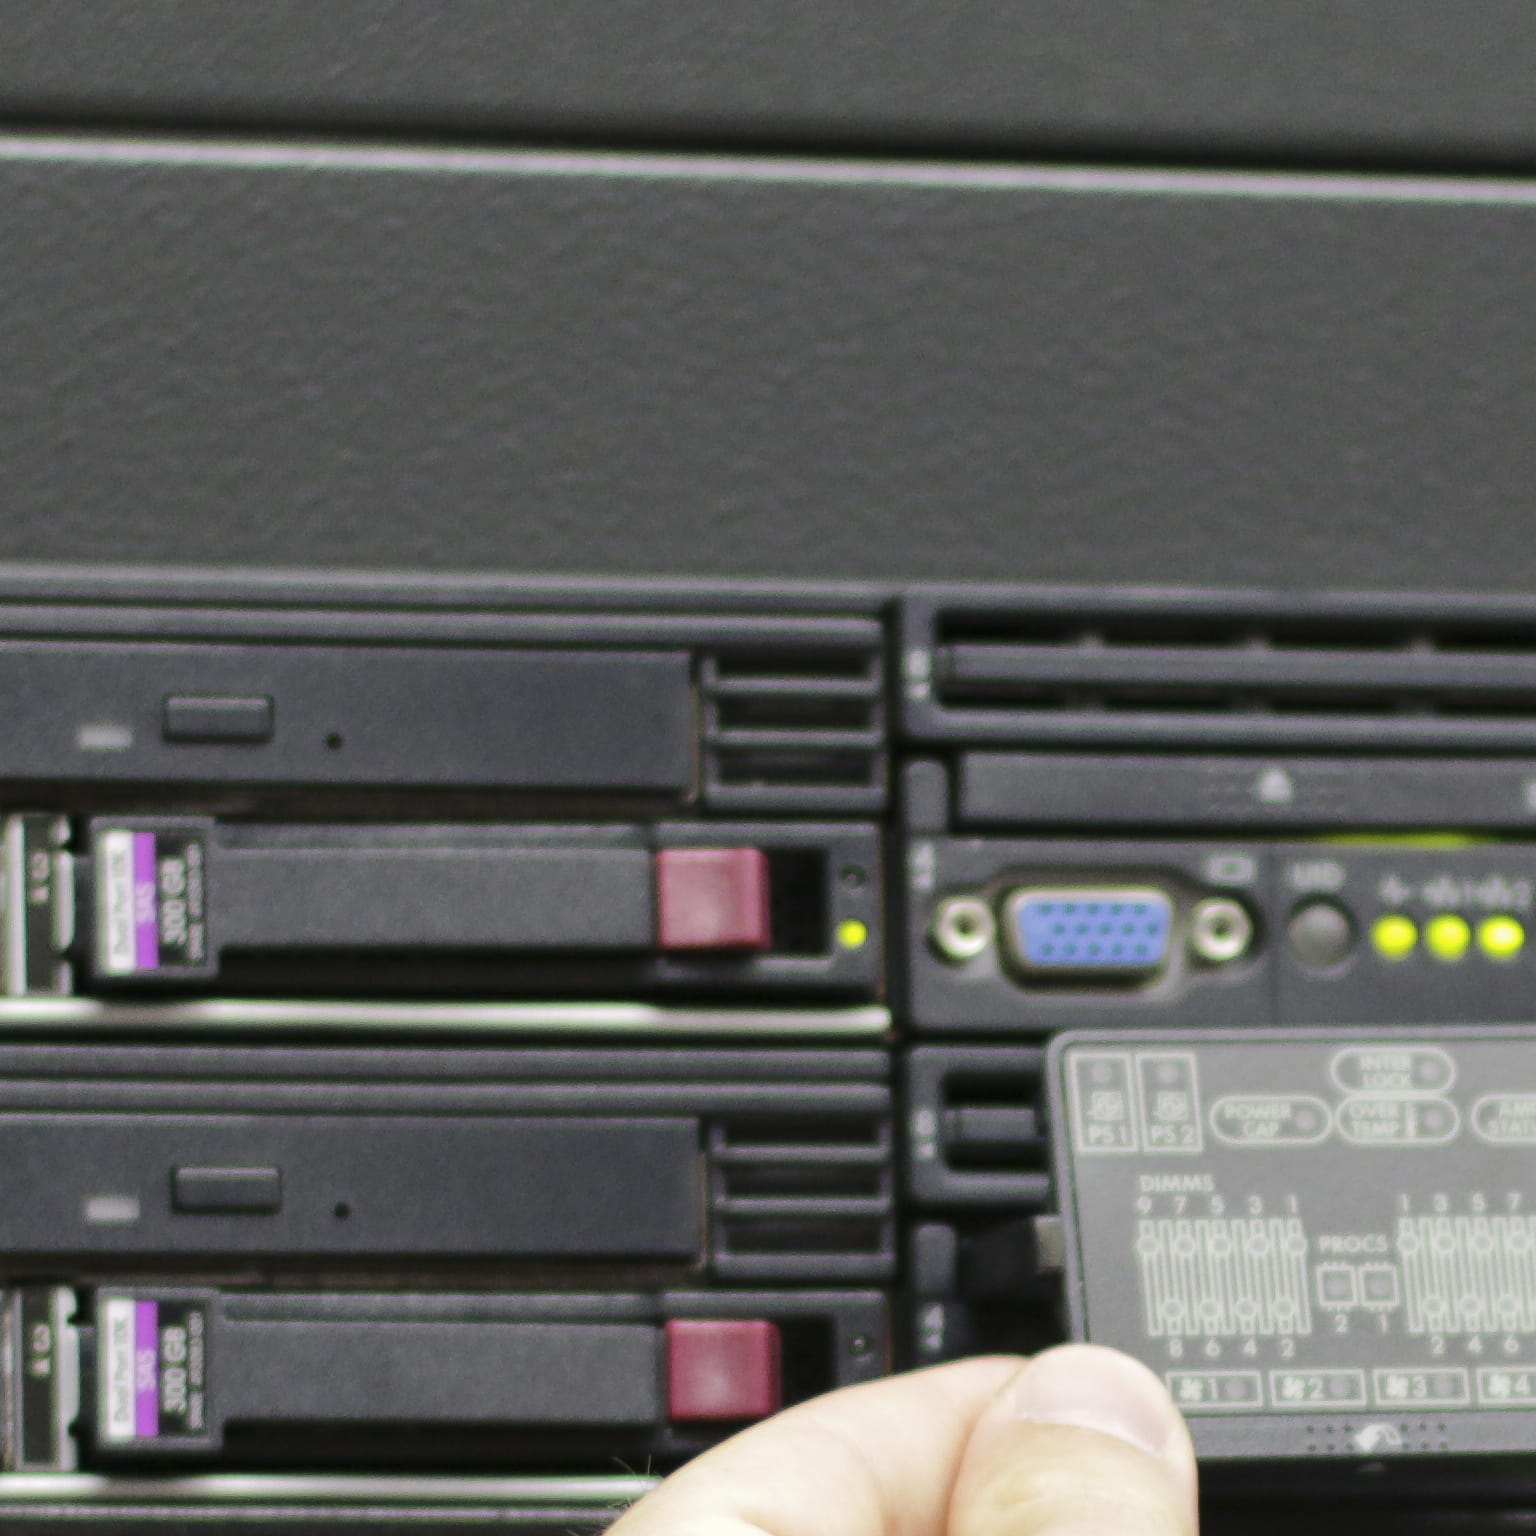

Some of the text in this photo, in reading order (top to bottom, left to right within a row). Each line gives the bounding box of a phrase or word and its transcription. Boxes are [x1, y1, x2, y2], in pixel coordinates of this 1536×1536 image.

[135, 881, 156, 924] SAS
[161, 859, 185, 945] 300 GB
[1224, 1104, 1291, 1119] POWER
[1349, 1103, 1398, 1119] OVER
[1088, 1126, 1114, 1143] PS
[1151, 1126, 1194, 1144] PS 2
[1243, 1121, 1278, 1137] CAP
[1352, 1121, 1398, 1137] TEMP
[1139, 1174, 1214, 1192] DIMMS
[1138, 1196, 1297, 1214] 9 7 5 3 1
[1400, 1193, 1409, 1211] 1
[1434, 1193, 1448, 1211] 3
[1472, 1193, 1486, 1211] 5
[1509, 1193, 1521, 1211] 7
[1319, 1236, 1387, 1252] PROCS
[1335, 1314, 1387, 1333] 2 1
[1206, 1338, 1220, 1357] 6
[1242, 1338, 1256, 1357] 4
[1281, 1338, 1294, 1357] 2
[1430, 1336, 1444, 1354] 2
[1468, 1336, 1482, 1354] 4
[1504, 1336, 1518, 1354] 6
[137, 1349, 156, 1392] SAS
[164, 1327, 186, 1412] 300 GB
[1208, 1378, 1217, 1399] 1
[1308, 1377, 1323, 1399] 2
[1412, 1376, 1426, 1397] 3
[1515, 1375, 1530, 1394] 4
